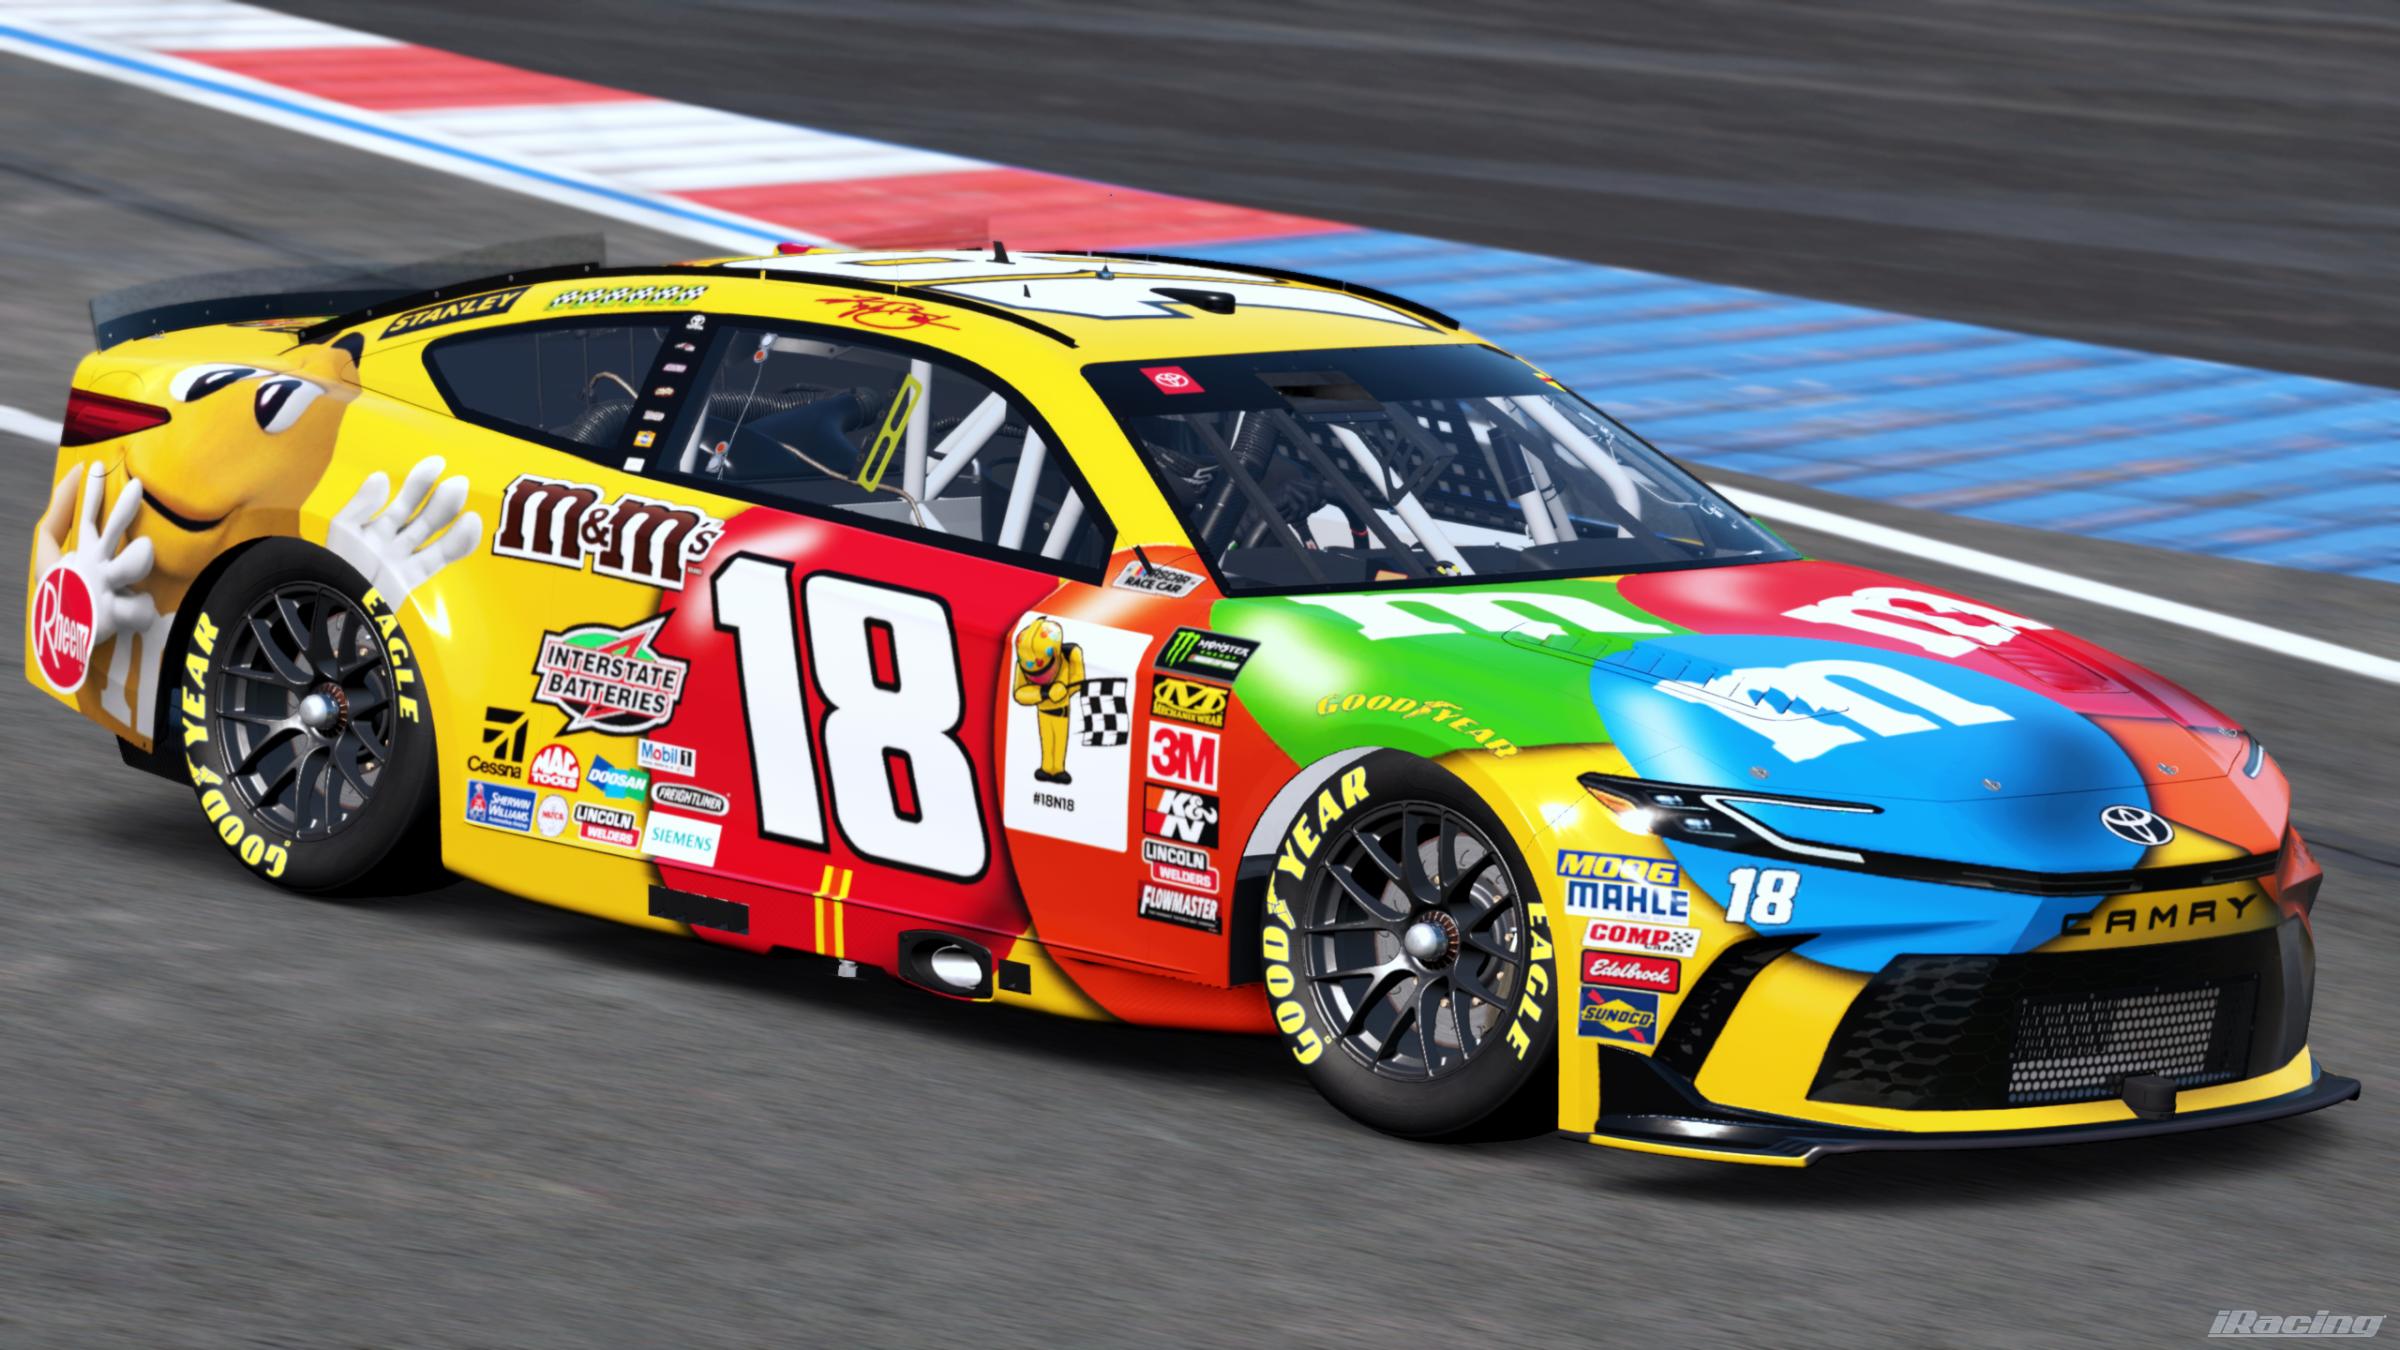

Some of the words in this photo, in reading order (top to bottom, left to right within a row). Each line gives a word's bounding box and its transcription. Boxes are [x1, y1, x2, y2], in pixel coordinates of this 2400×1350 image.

[388, 291, 518, 333] STANLEY
[1124, 576, 1155, 589] RACE
[1156, 579, 1182, 594] CAR
[38, 568, 90, 669] Rheem
[361, 586, 419, 724] EAGLE
[1197, 639, 1251, 657] MONSTER
[547, 645, 678, 690] INTERSTATE
[549, 672, 667, 714] BATTERIES
[712, 552, 989, 883] 18
[1316, 693, 1521, 759] GOODYEAR
[182, 612, 289, 878] GOODYEAR
[641, 741, 678, 765] Mobil
[1152, 728, 1216, 786] 3M
[467, 755, 521, 779] Cessna
[531, 746, 579, 776] MAC
[532, 773, 578, 790] TOOLS
[588, 767, 647, 791] DOOSAN
[488, 804, 531, 822] WILLIAMS
[492, 792, 531, 810] SHERWIN
[657, 786, 723, 812] FREIGHTLINER
[1033, 792, 1075, 812] #18N18
[576, 805, 632, 830] LINCOLN
[587, 825, 634, 844] WELDERS
[652, 826, 712, 851] SIEMENS
[1146, 842, 1205, 870] LINCOLN
[1559, 853, 1677, 884] MOOG
[1159, 865, 1212, 888] WELDERS
[1140, 885, 1218, 921] FLOWMASTER
[1568, 880, 1689, 918] MAHLE
[1724, 867, 1802, 926] 18
[1263, 766, 1370, 1065] GOODYEAR
[2060, 894, 2258, 936] CAMRY
[1589, 923, 1671, 946] COMP
[1506, 902, 1554, 1061] EAGLE
[1589, 958, 1671, 984] Edelbrock
[1585, 1006, 1653, 1027] SUNOCO
